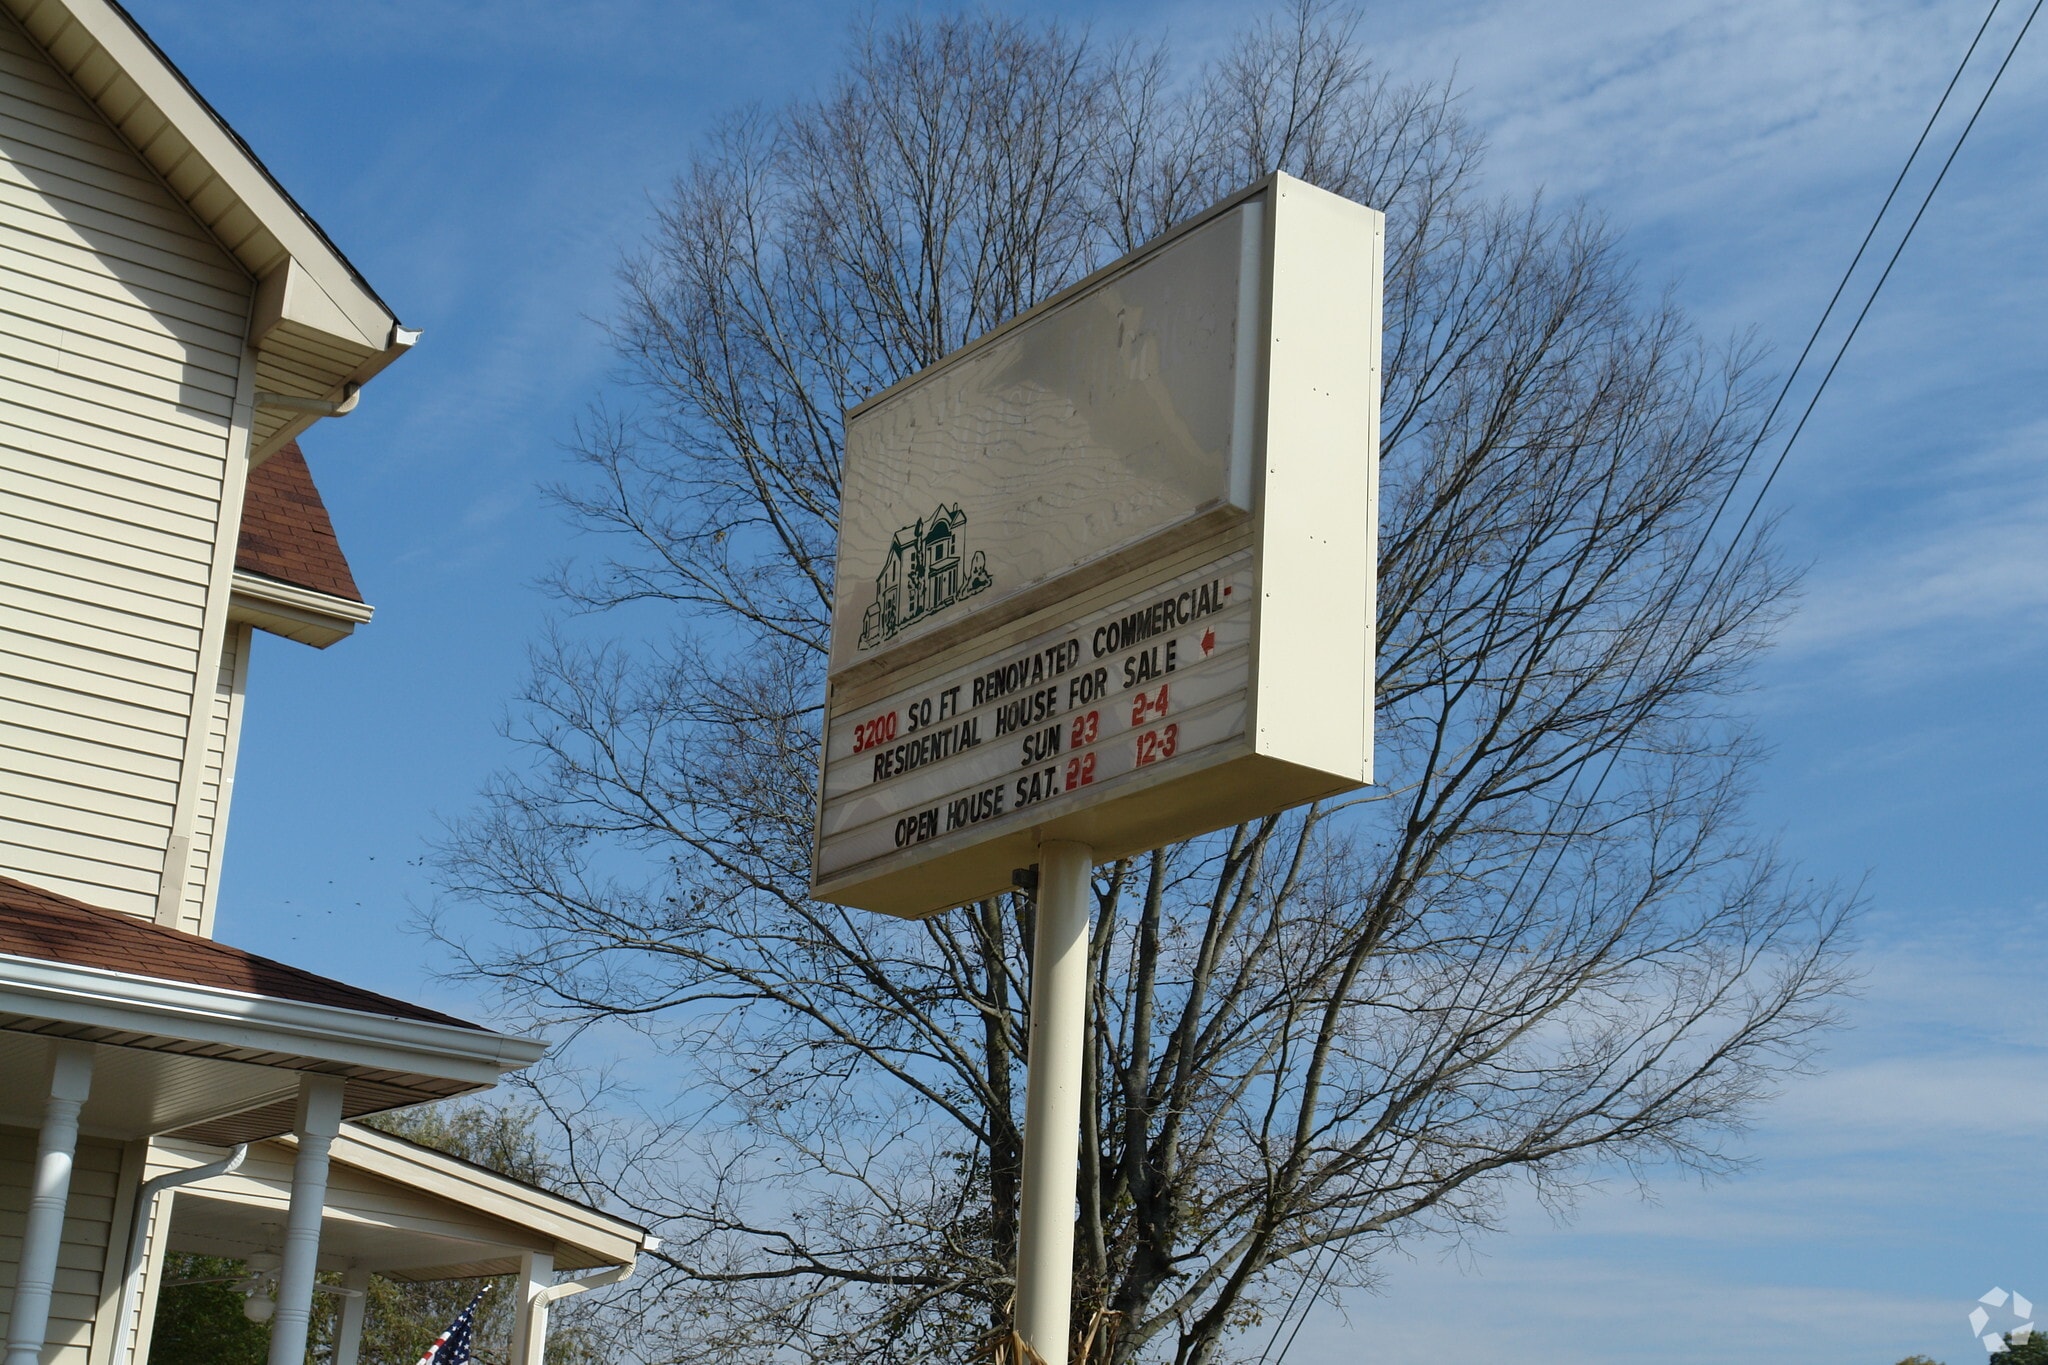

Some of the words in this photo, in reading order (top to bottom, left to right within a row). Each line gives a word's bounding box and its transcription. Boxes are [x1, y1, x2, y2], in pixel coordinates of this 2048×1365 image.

[853, 711, 897, 753] 3200
[940, 686, 960, 720] FT
[973, 639, 1080, 707] RENOVATED
[873, 717, 981, 783] RESIDENTIAL
[996, 686, 1057, 737] HOUSE
[1069, 669, 1108, 710] FOR
[1124, 639, 1176, 689] SALE
[1021, 724, 1061, 766] SUN
[1071, 710, 1099, 749] 23
[1131, 684, 1169, 726] 2-4
[895, 807, 939, 848] OPEN
[946, 784, 1004, 832] HOUSE
[1015, 767, 1059, 807] SAT.
[1066, 752, 1097, 791] 22
[1136, 724, 1178, 768] 12-3
